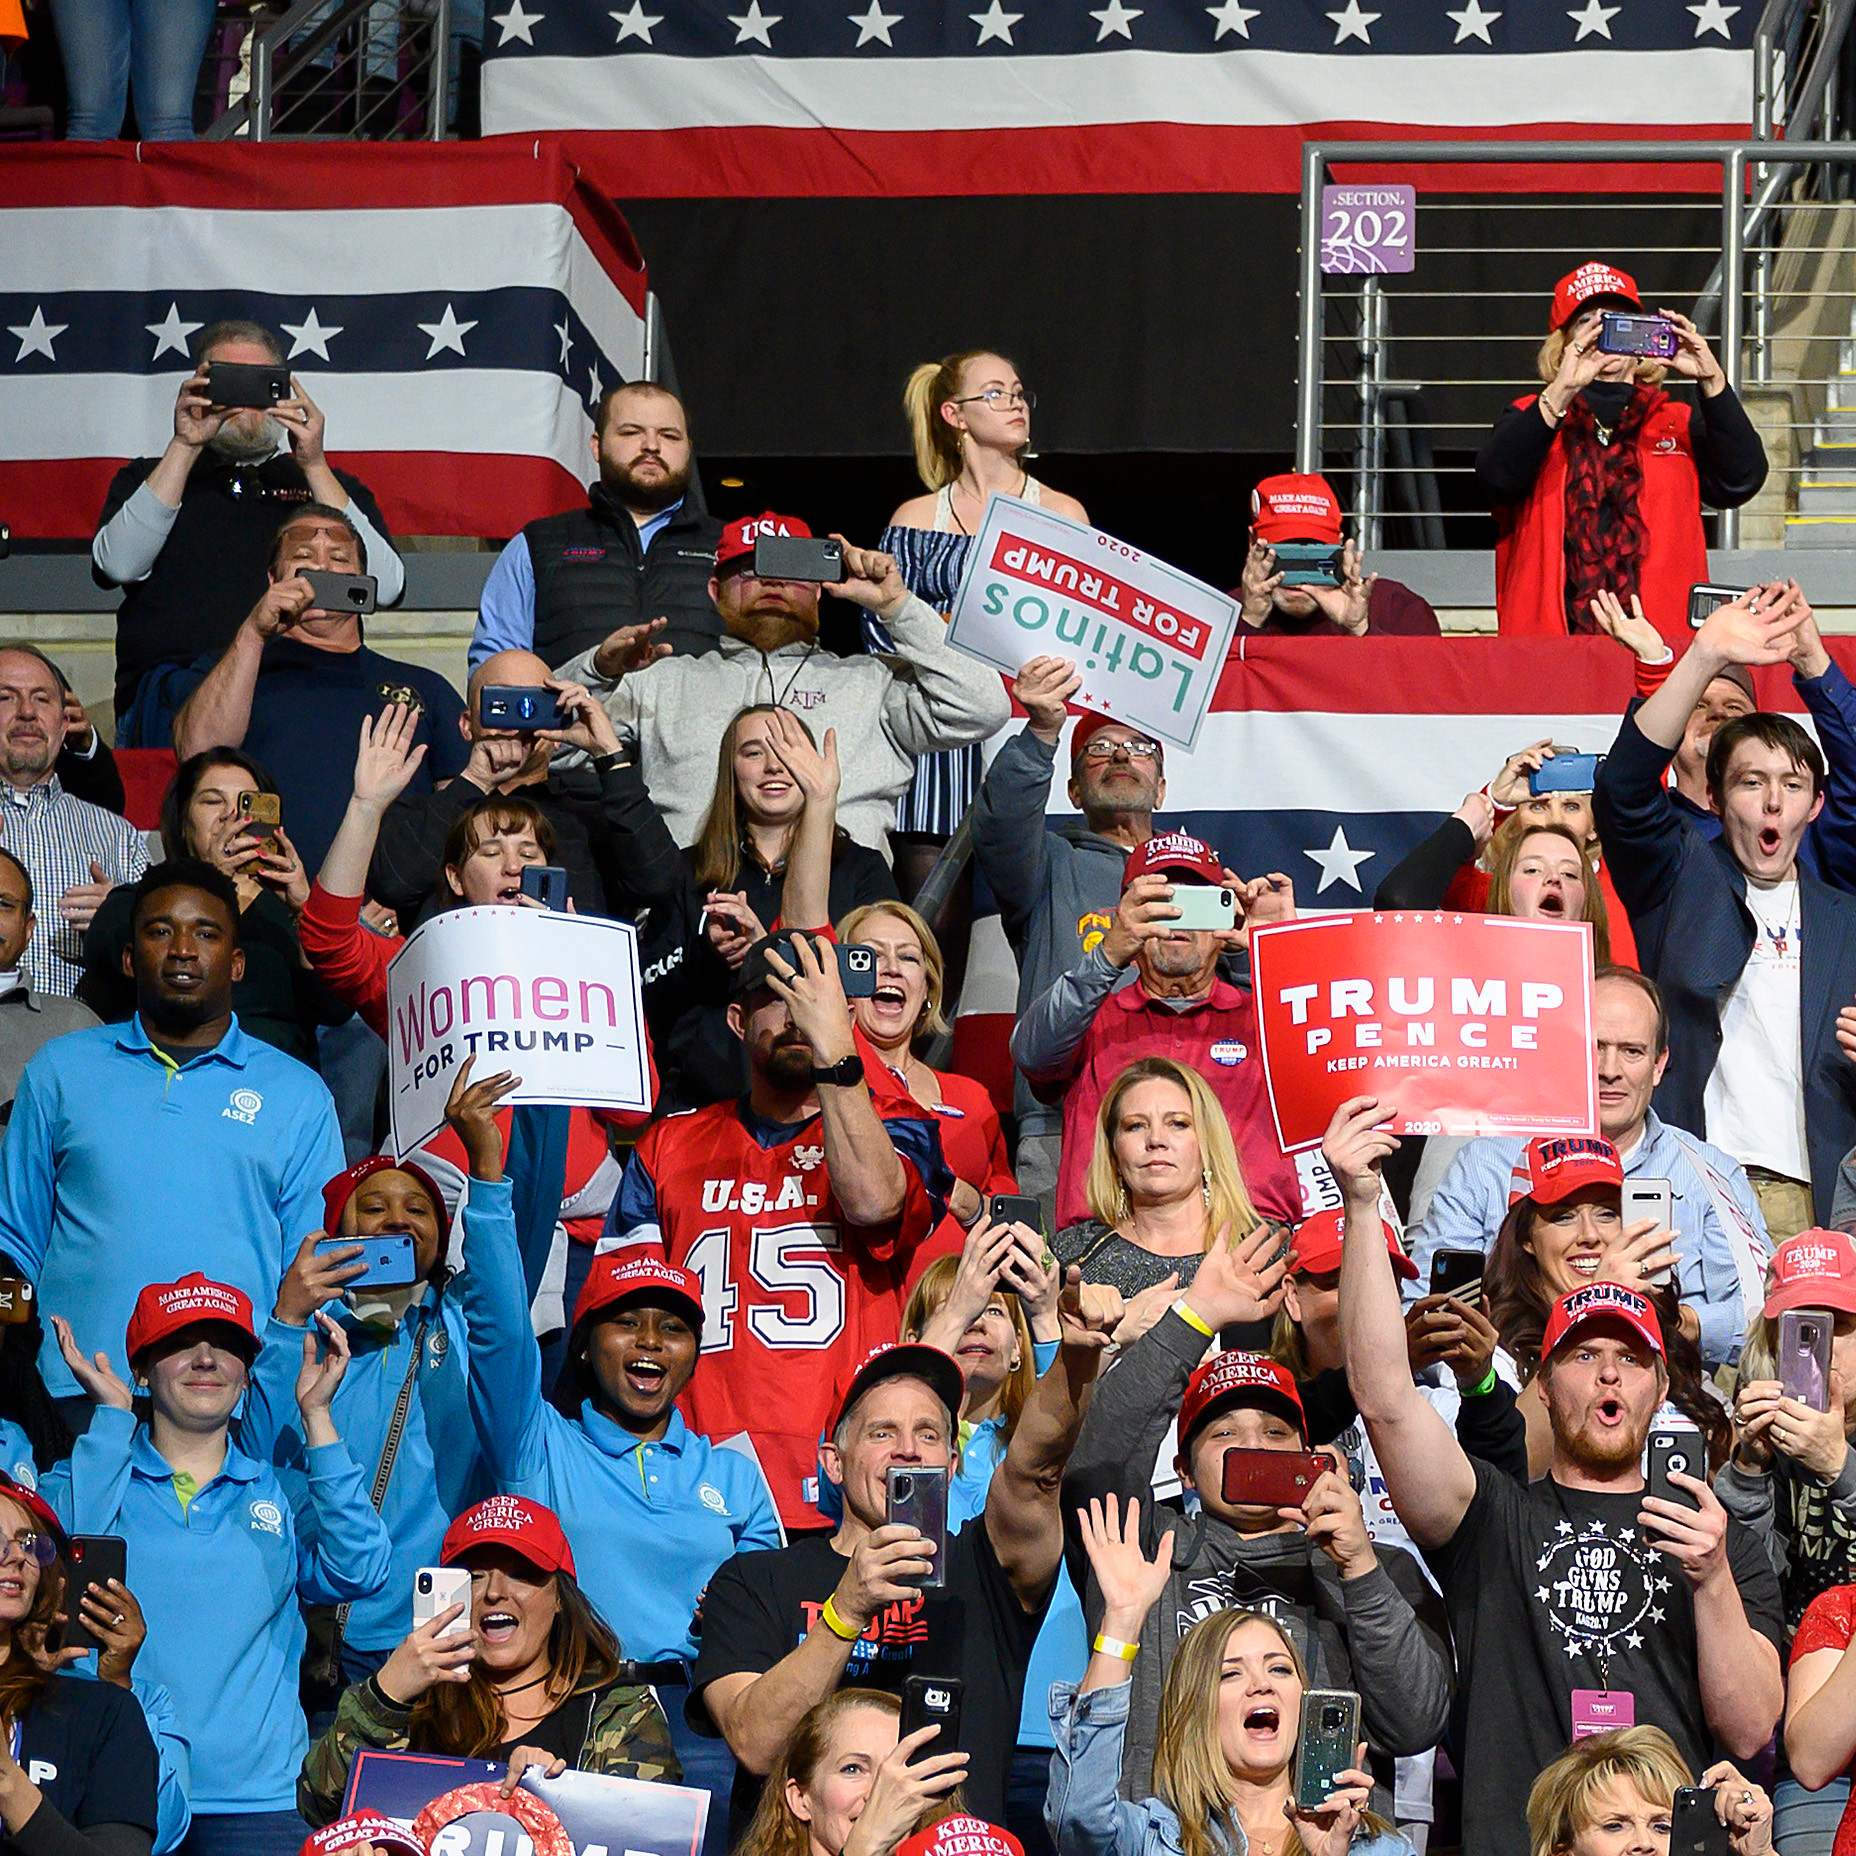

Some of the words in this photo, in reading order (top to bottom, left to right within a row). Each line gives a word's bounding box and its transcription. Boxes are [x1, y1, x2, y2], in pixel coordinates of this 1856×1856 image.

[1337, 191, 1402, 206] SECTION
[1329, 210, 1408, 248] 202
[1577, 263, 1609, 278] KEEP
[1567, 273, 1626, 296] AMERICA
[1575, 285, 1617, 301] GREAT
[742, 520, 790, 544] USA
[1098, 533, 1140, 564] 2020
[1001, 546, 1121, 613] TRUMP
[1132, 595, 1203, 653] FOR
[982, 580, 1194, 713] Latinos
[1279, 978, 1564, 1026] TRUMP
[399, 973, 617, 1066] Women
[1307, 1020, 1538, 1054] PENCE
[413, 1043, 455, 1090] FOR
[462, 1029, 596, 1060] TRUMP
[1327, 1056, 1369, 1074] KEEP
[1373, 1053, 1451, 1070] AMERICA
[1456, 1053, 1518, 1071] GREAT!
[222, 1107, 256, 1126] ASEZ
[1405, 1121, 1441, 1134] 2020
[702, 1177, 818, 1212] U.S.A.
[686, 1223, 847, 1350] 45
[1563, 1288, 1648, 1314] TRUMP
[466, 1505, 533, 1526] AMERICA
[483, 1496, 520, 1511] KEEP
[473, 1515, 523, 1533] GREAT
[1574, 1547, 1617, 1572] GOD
[1567, 1567, 1622, 1592] GUNS
[1556, 1583, 1628, 1613] TRUMP
[936, 1816, 990, 1841] KEEP
